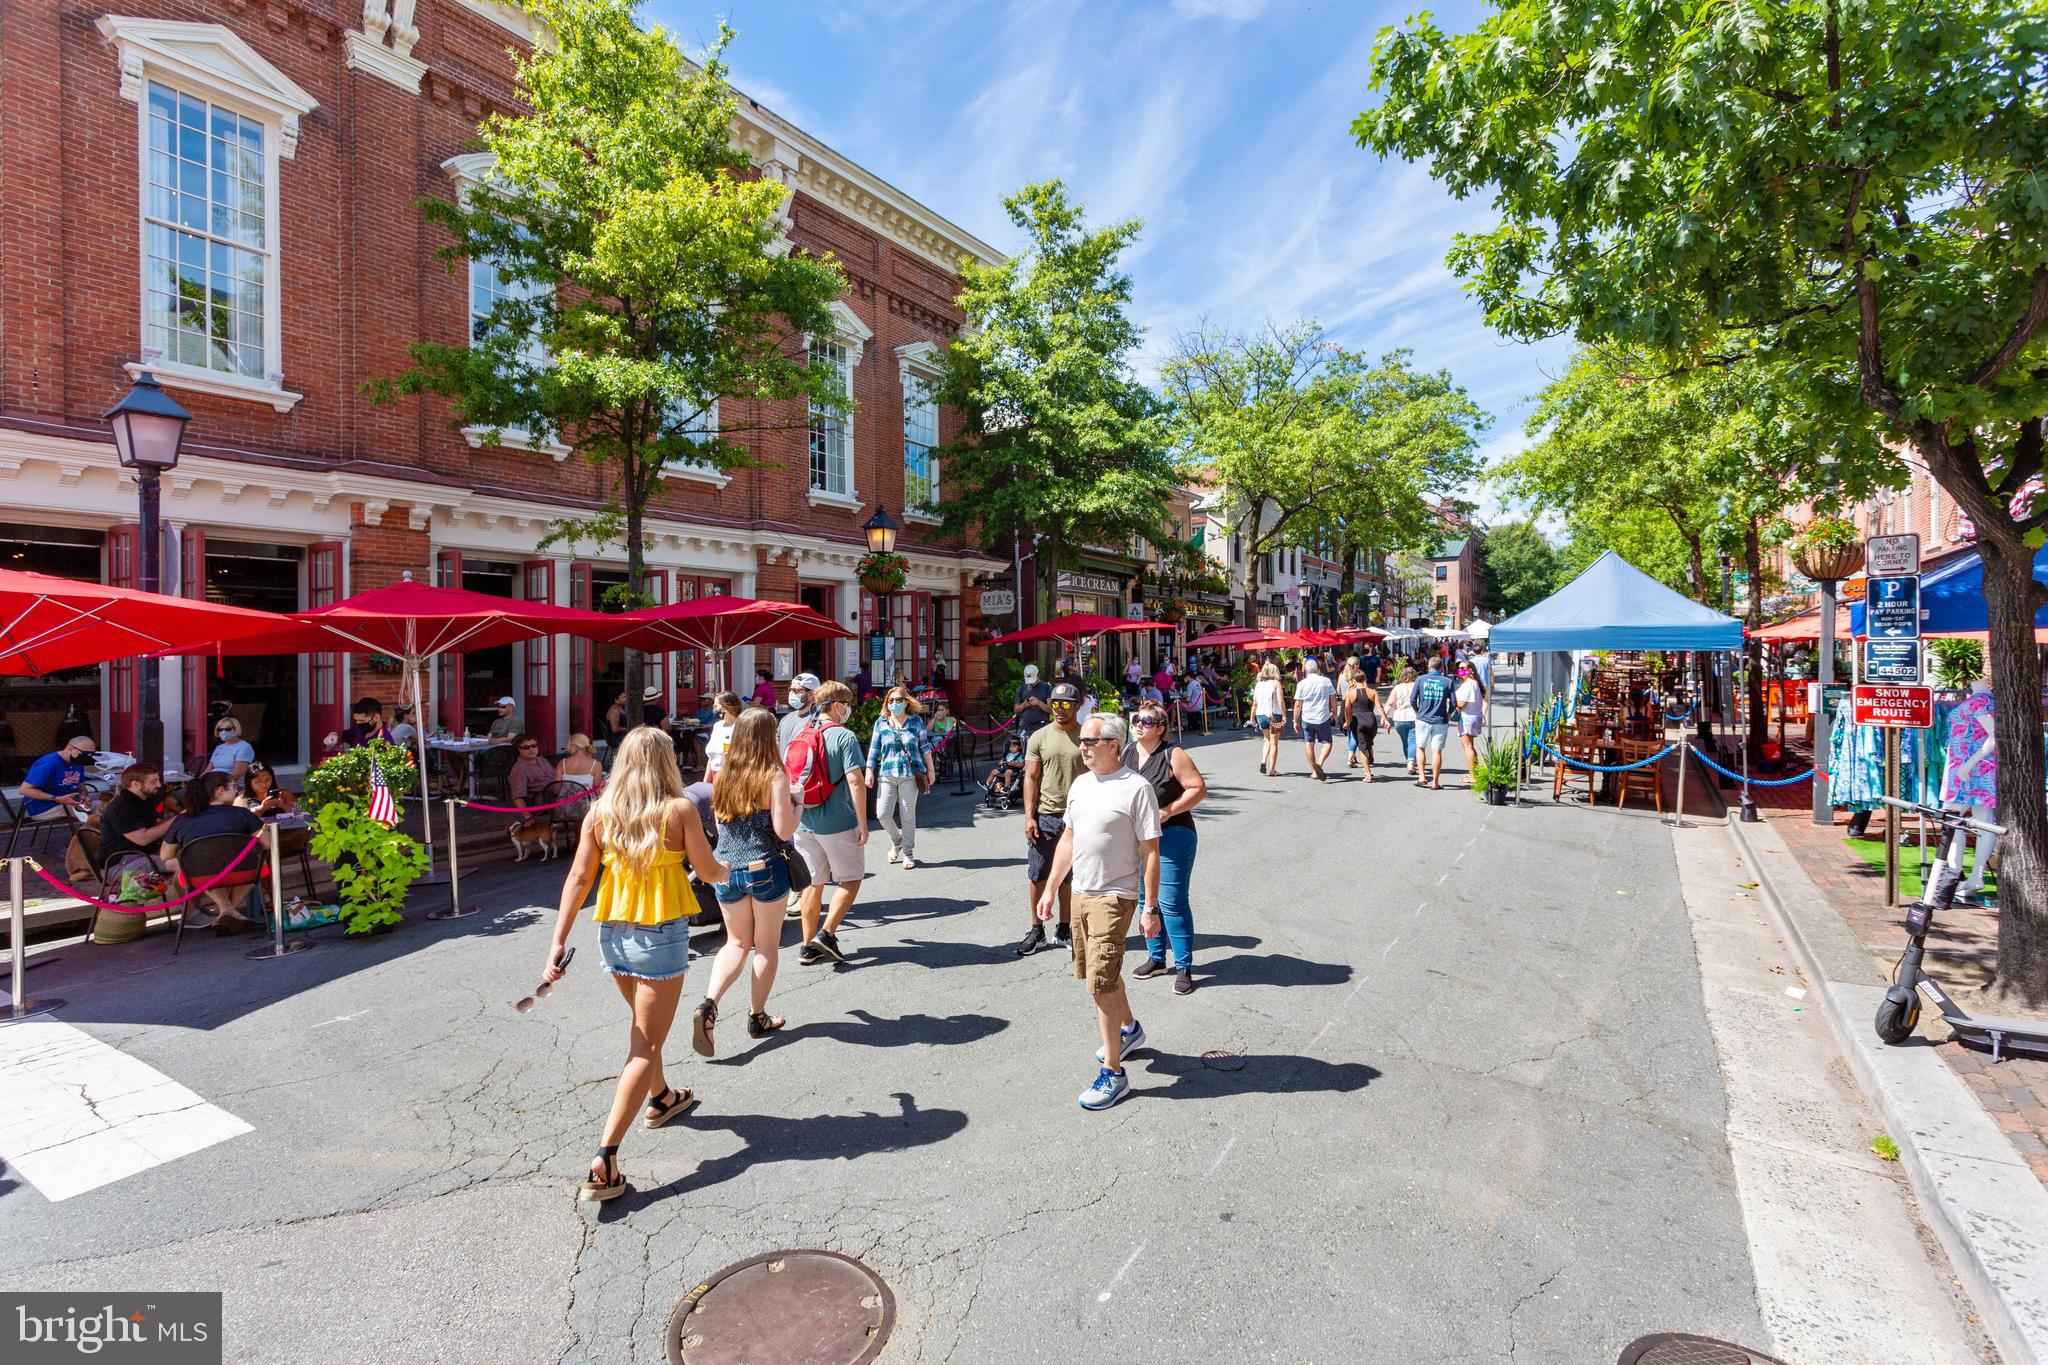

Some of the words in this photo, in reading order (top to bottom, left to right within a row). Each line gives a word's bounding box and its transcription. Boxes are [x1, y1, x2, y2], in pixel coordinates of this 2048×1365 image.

[1072, 575, 1087, 588] ICE
[1087, 577, 1119, 592] CREAM
[1885, 581, 1901, 598] P
[983, 594, 1012, 606] MIA'S
[1875, 688, 1910, 697] SNOW
[1856, 698, 1928, 708] EMERGENCY
[1873, 708, 1911, 717] ROUTE
